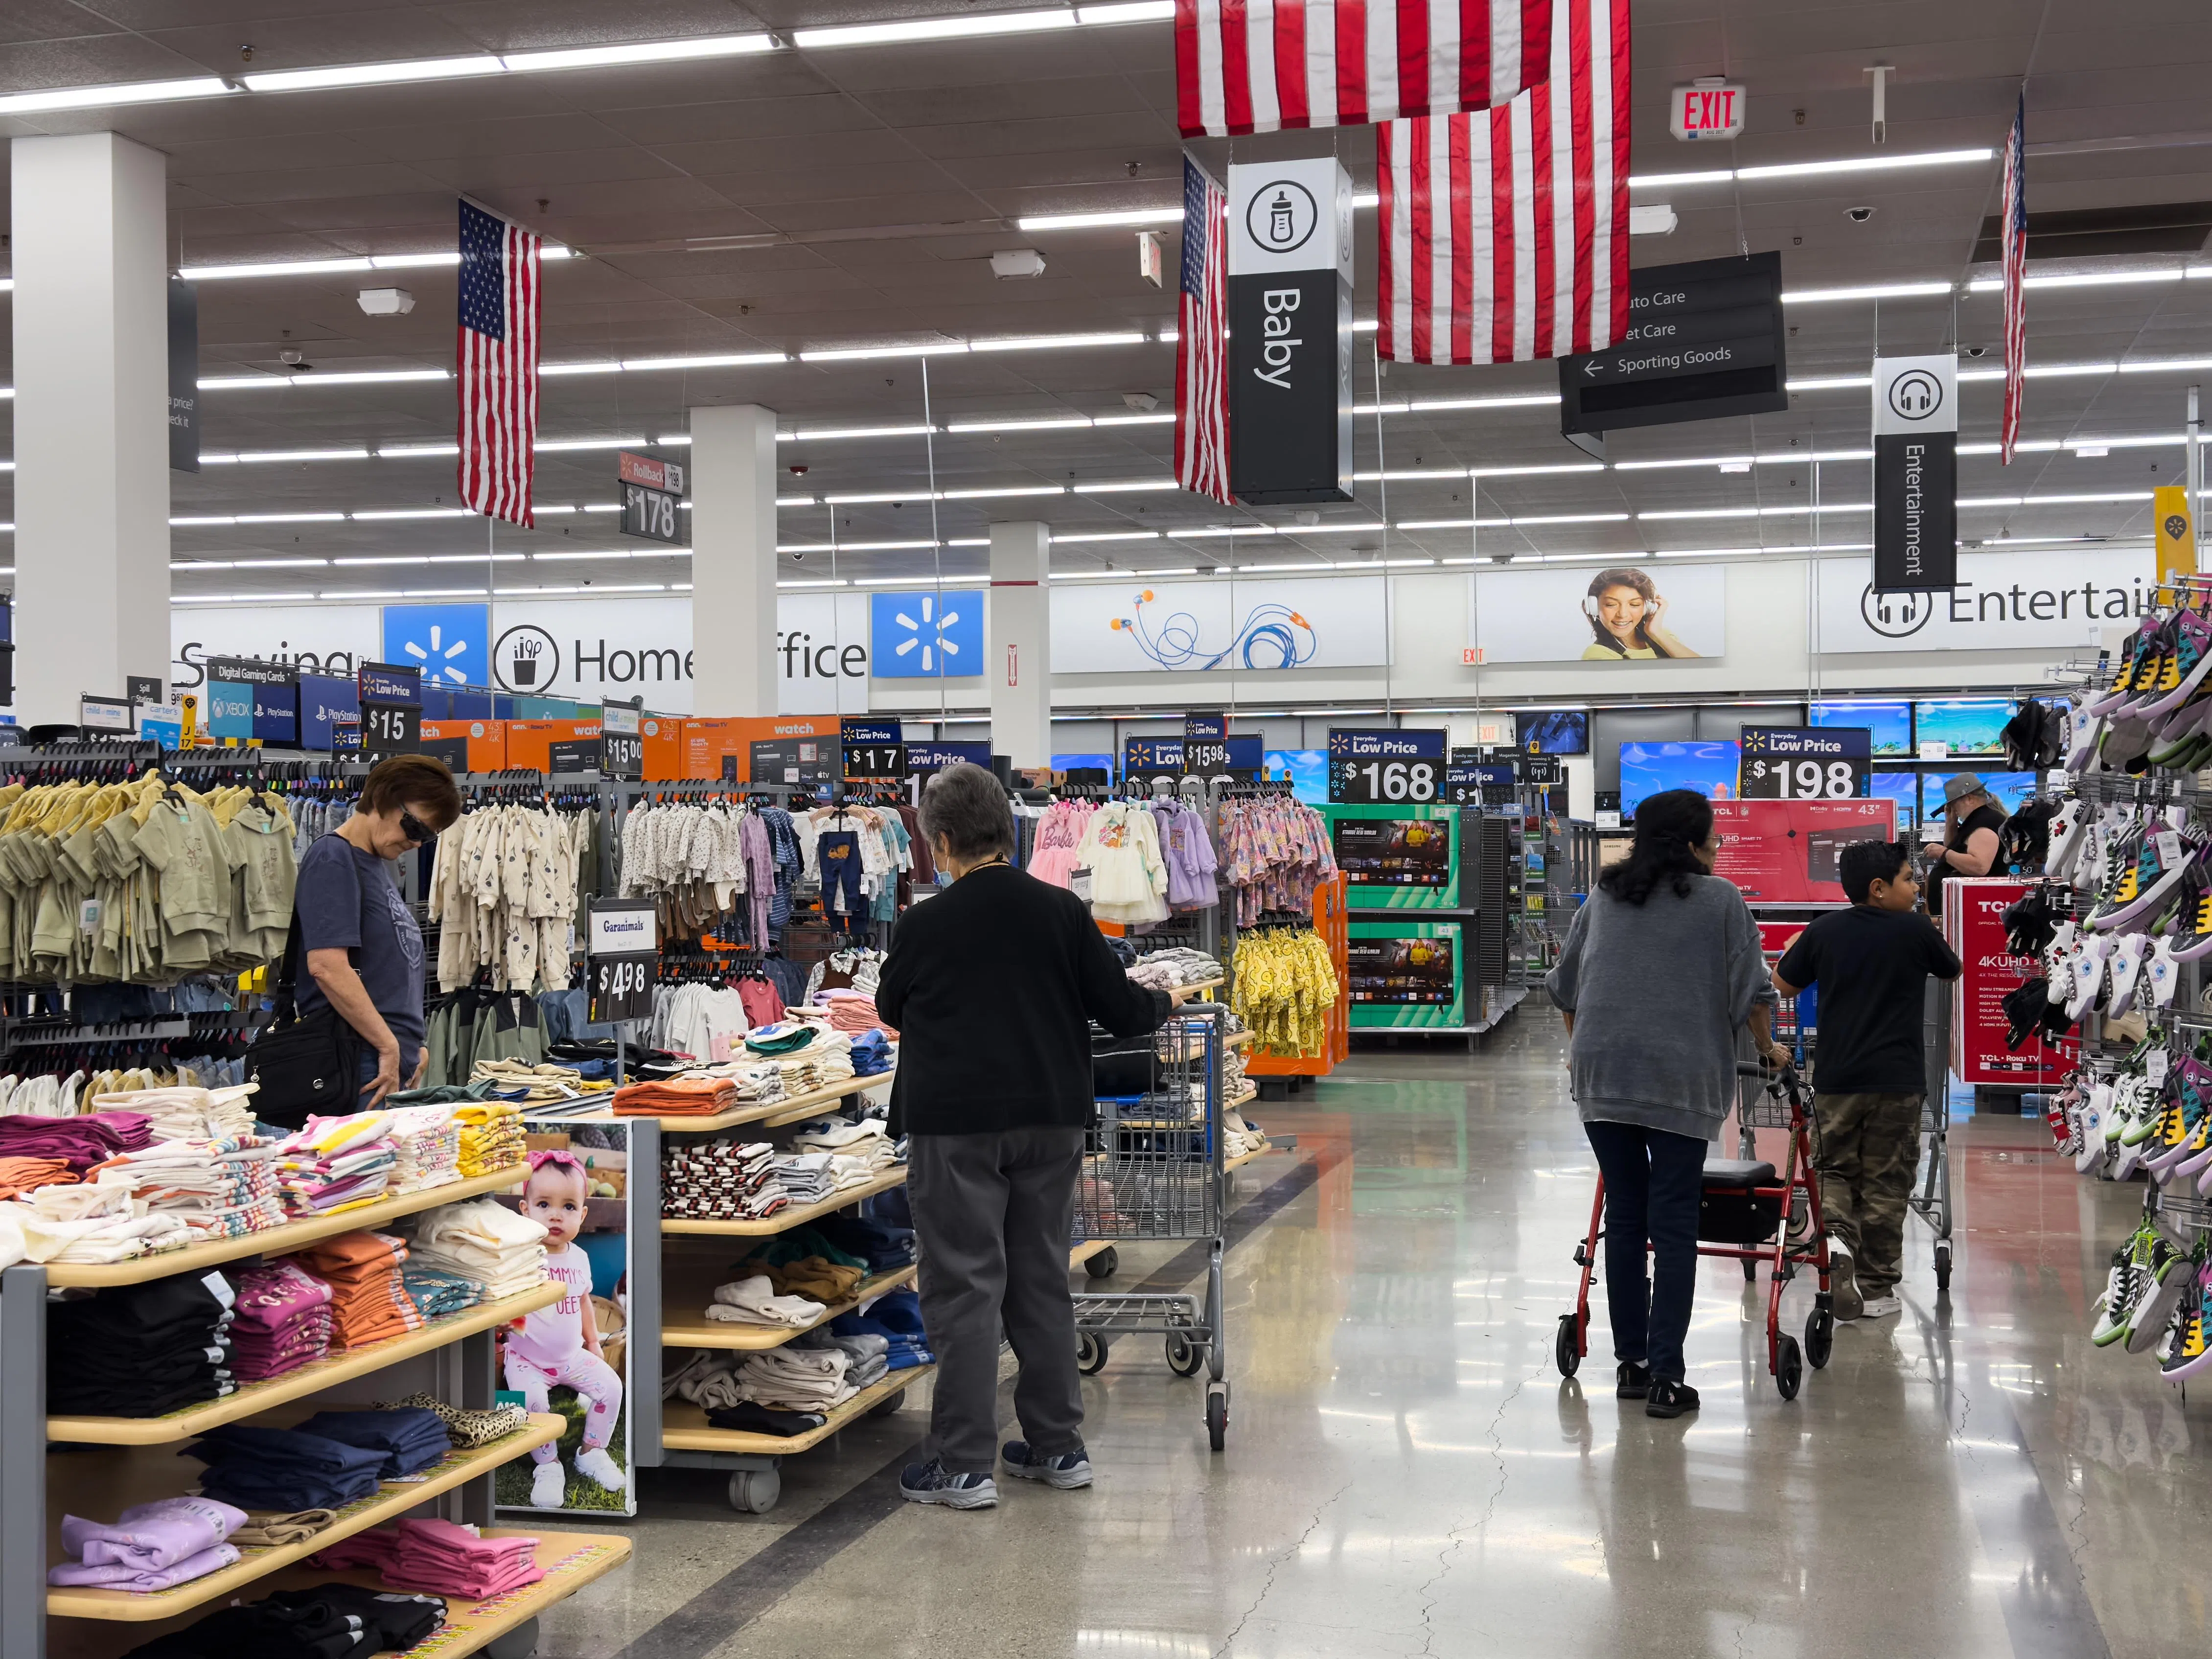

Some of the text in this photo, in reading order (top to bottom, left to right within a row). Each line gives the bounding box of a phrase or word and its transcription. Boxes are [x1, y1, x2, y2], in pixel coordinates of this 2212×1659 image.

[1684, 90, 1735, 129] EXIT
[1630, 291, 1685, 309] to Care
[1254, 288, 1302, 389] Baby
[1626, 323, 1676, 341] et Care
[1618, 347, 1731, 374] Sporting Goods
[174, 397, 193, 410] price?
[168, 415, 188, 428] eck it
[634, 463, 664, 483] Rollback
[627, 487, 674, 537] $178
[1906, 444, 1925, 576] Entertainment
[778, 631, 867, 678] fice
[1464, 649, 1483, 662] EXT
[181, 641, 352, 688] Sin
[219, 666, 285, 683] Digital Gaming Cards
[139, 684, 150, 693] Spill
[376, 685, 410, 696] Low Price
[86, 706, 100, 715] child
[106, 708, 121, 716] mine
[150, 706, 178, 716] carter's
[226, 702, 250, 716] XBOX
[268, 708, 294, 718] PlayStation
[328, 709, 362, 722] PlayStation
[606, 711, 619, 722] child
[184, 726, 190, 735] J
[369, 709, 405, 740] $15
[574, 725, 602, 735] watc
[774, 723, 814, 734] watch
[420, 726, 440, 737] tch
[663, 733, 675, 741] 4K
[1479, 726, 1496, 740] EXIT
[182, 739, 191, 747] 17
[1353, 741, 1417, 754] Low Price
[1771, 739, 1842, 752] Low Price
[853, 749, 897, 769] $17
[934, 753, 966, 764] Price
[1345, 762, 1434, 801] $168
[1447, 773, 1494, 782] Low Pice
[1753, 760, 1854, 799] $198
[1041, 825, 1074, 850] Barbie
[603, 917, 644, 933] Garanimals
[541, 1267, 585, 1285] MMY'S
